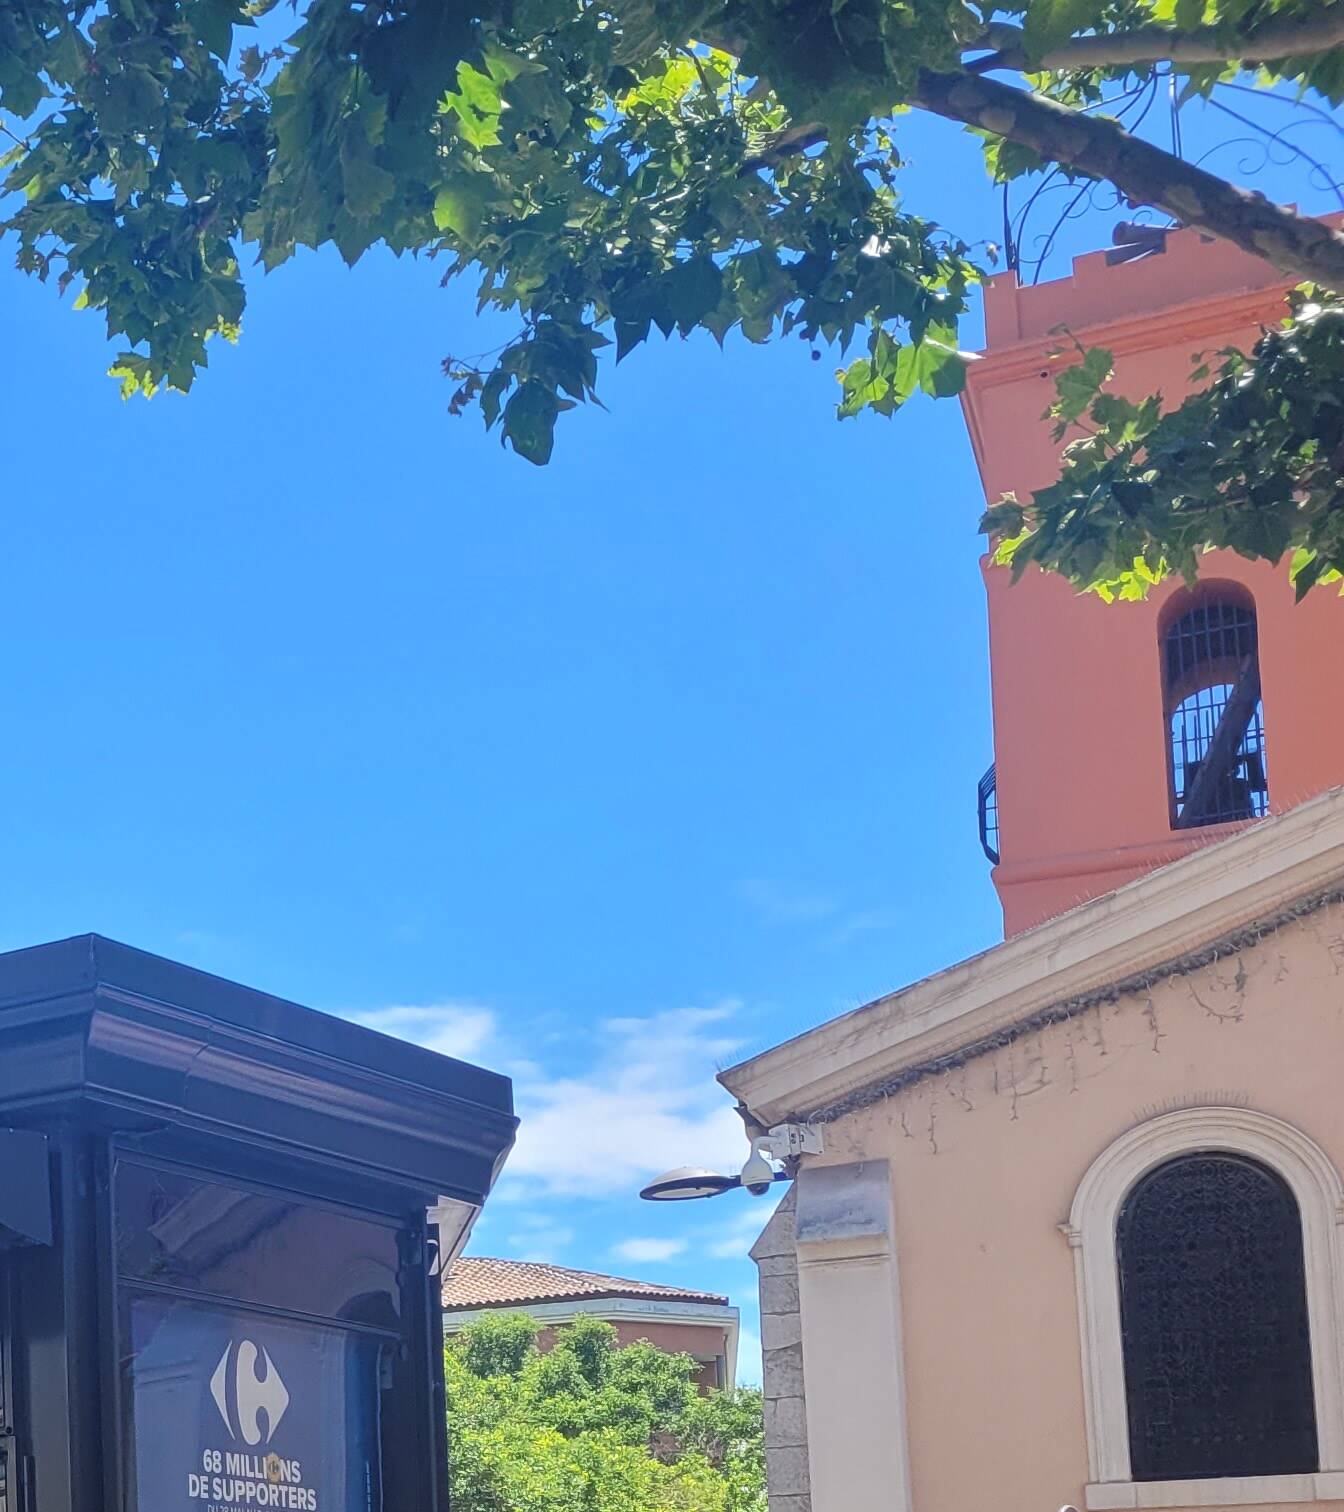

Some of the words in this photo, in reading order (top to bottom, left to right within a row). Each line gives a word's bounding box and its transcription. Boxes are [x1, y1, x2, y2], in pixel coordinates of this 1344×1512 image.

[203, 1449, 222, 1473] 68
[189, 1474, 209, 1499] DE
[212, 1477, 317, 1511] SUPPORTERS
